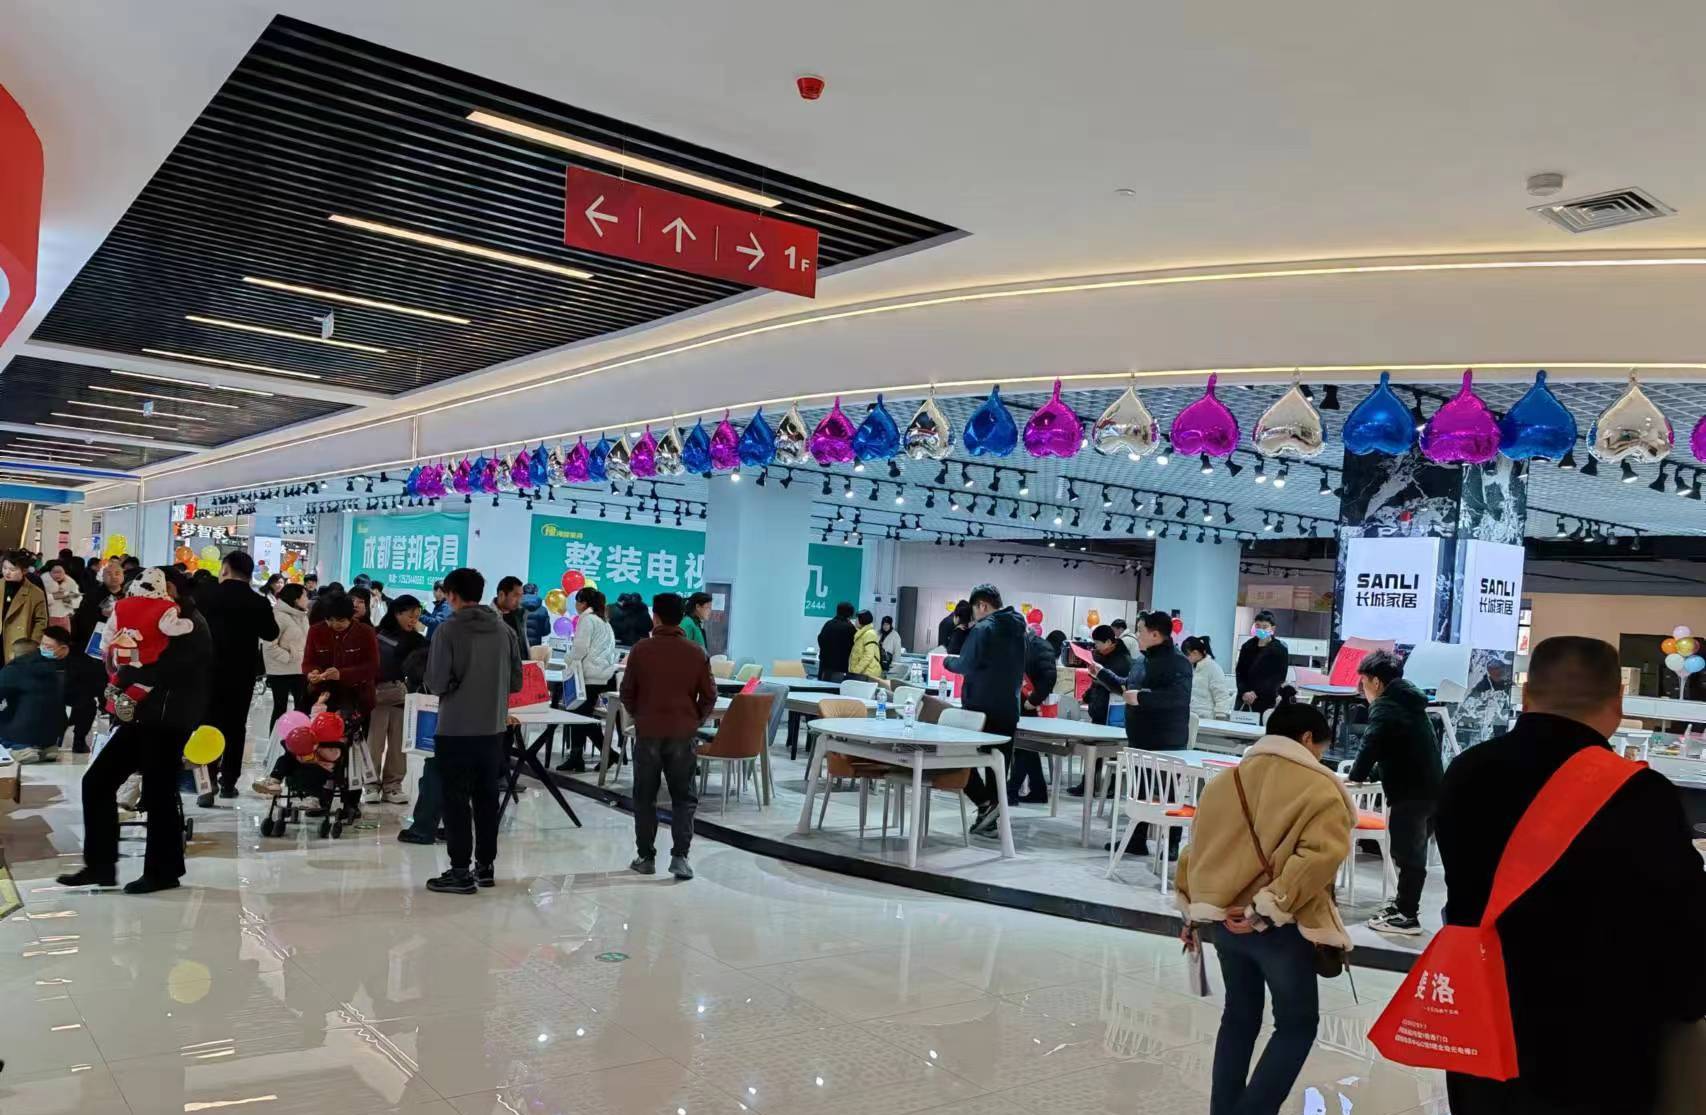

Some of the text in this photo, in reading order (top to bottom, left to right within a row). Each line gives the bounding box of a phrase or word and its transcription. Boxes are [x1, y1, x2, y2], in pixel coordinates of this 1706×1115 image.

[784, 246, 810, 272] 1F
[181, 523, 228, 539] 梦智家
[363, 534, 459, 572] 成都誉邦家具
[1357, 573, 1420, 590] SANLI
[1480, 578, 1516, 597] SANLI
[1356, 592, 1418, 609] 长城家居
[1479, 599, 1514, 616] 长城家居
